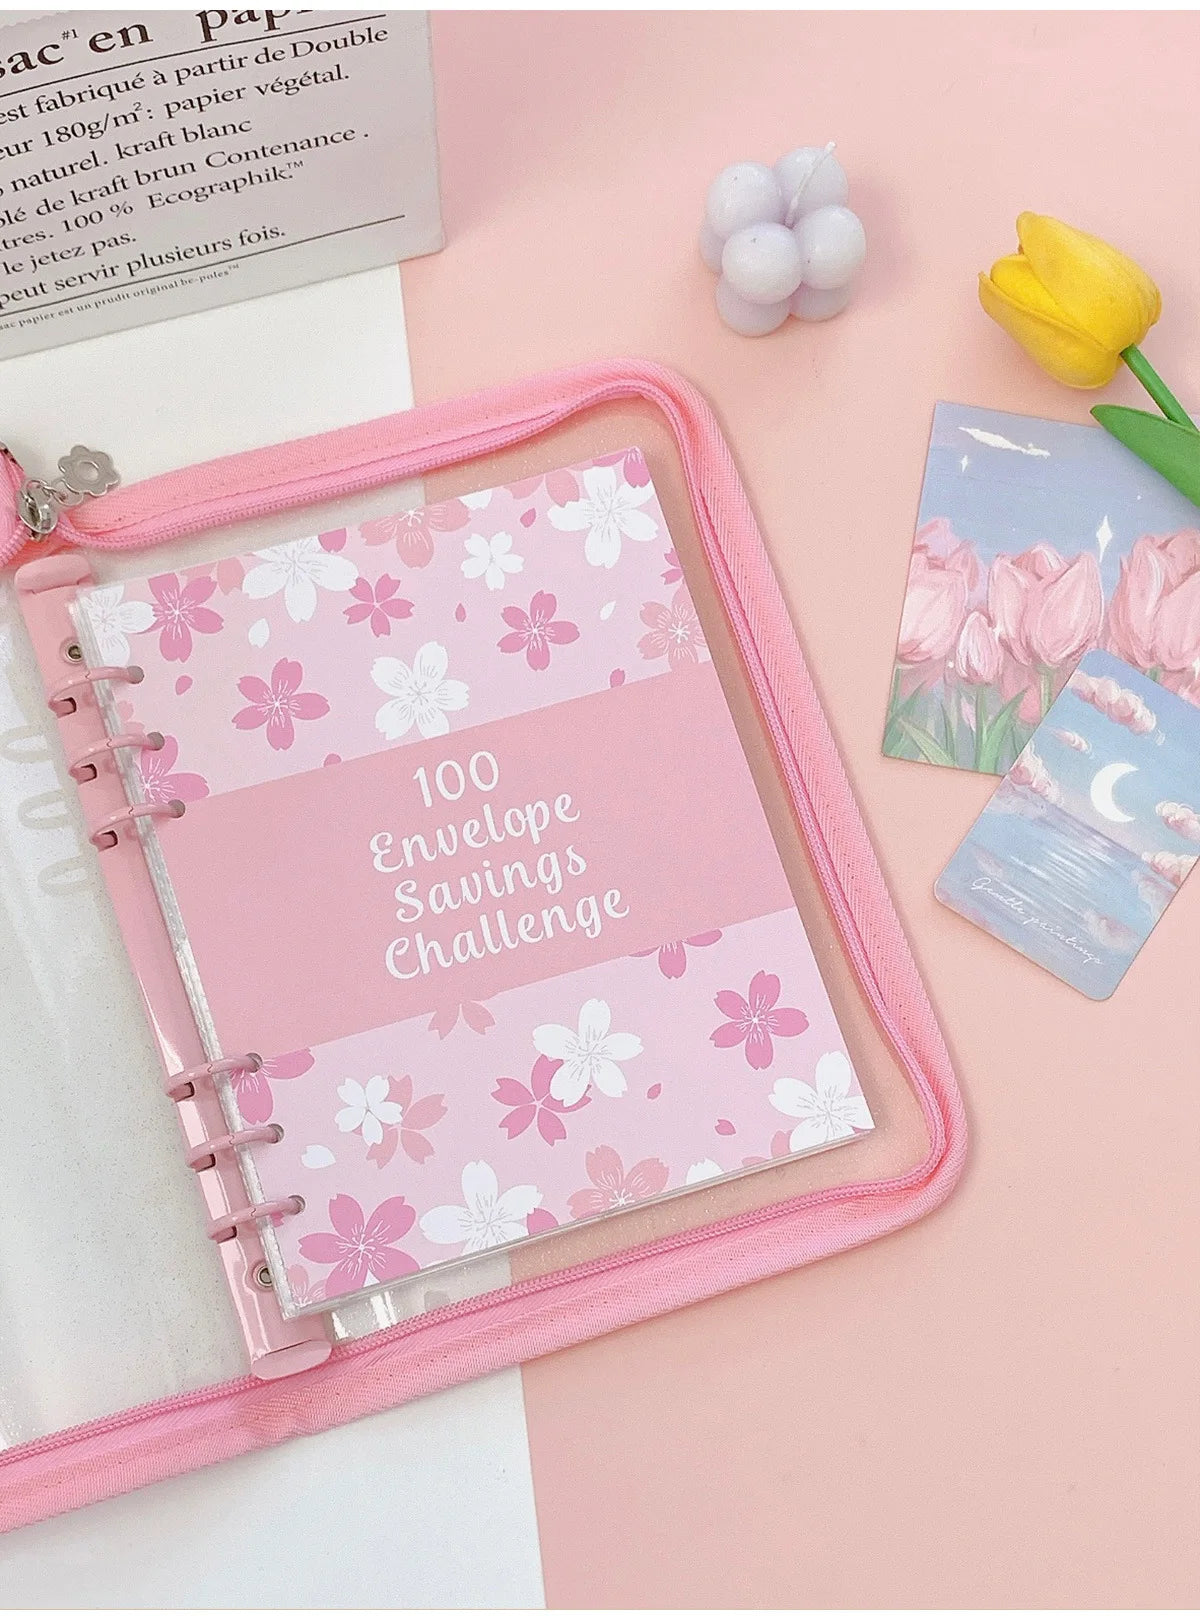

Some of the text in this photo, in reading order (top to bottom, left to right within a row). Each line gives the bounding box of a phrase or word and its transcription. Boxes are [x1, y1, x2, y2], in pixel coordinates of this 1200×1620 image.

[89, 23, 153, 53] en
[196, 10, 313, 43] pap
[0, 27, 388, 125] est fabriqué à partir de Double
[165, 88, 246, 118] papier
[255, 64, 349, 95] végétal.
[11, 120, 252, 192] naturel. kraft blanc
[36, 199, 65, 216] de
[70, 175, 130, 207] kraft
[134, 162, 196, 186] brun
[205, 129, 355, 168] Contenance
[62, 211, 103, 232] 100
[110, 201, 134, 218] %
[2, 233, 137, 275] le jetez pas.
[54, 264, 120, 291] servir
[126, 238, 232, 276] plusieurs
[239, 225, 286, 247] fois.
[412, 751, 499, 807] 100
[369, 793, 580, 873] Envelope
[394, 845, 587, 923] Savings
[385, 889, 630, 979] Challenge
[1023, 917, 1104, 964] paintings
